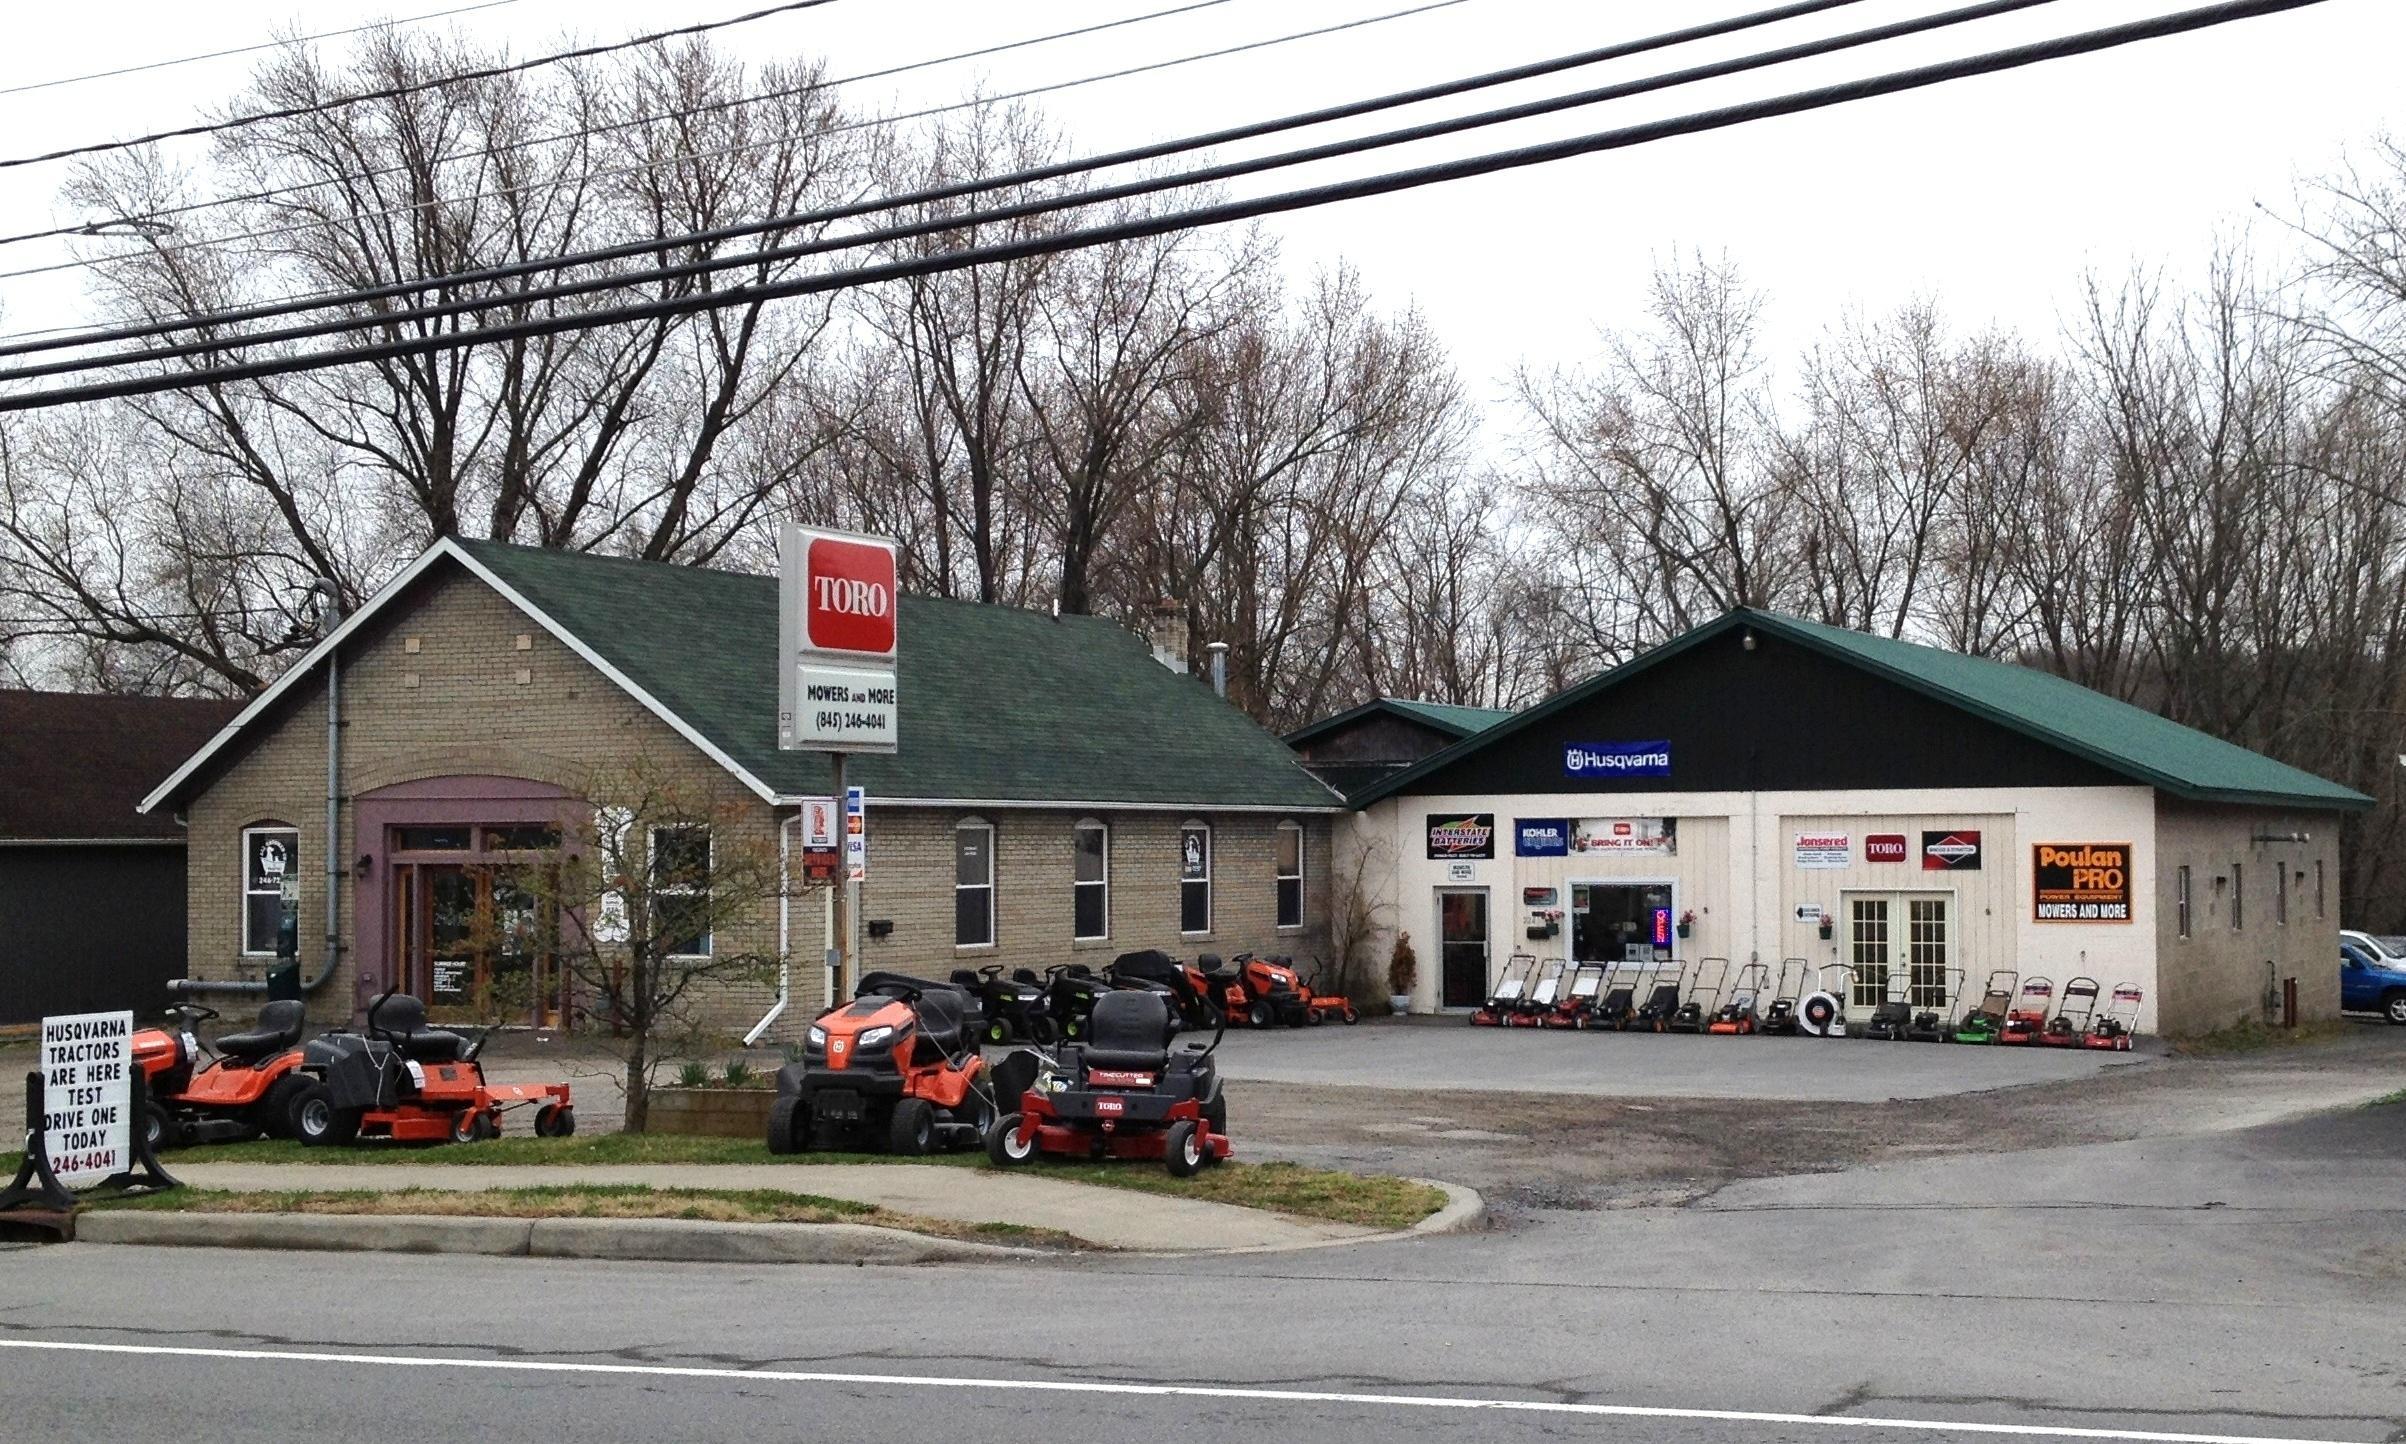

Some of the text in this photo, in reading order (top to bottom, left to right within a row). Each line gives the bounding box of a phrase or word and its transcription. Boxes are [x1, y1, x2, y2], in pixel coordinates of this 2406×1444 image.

[814, 575, 888, 617] TORO
[807, 684, 895, 705] MOWERS AND MORE
[816, 711, 886, 732] (845) 246-4041
[1584, 751, 1669, 770] Husqvarna
[1430, 826, 1491, 838] INTERSTATE
[1432, 837, 1487, 846] BATTERIES
[1522, 828, 1558, 838] KOHLER
[1591, 838, 1621, 847] BRING
[1623, 838, 1634, 847] IT
[1797, 836, 1848, 846] Jonsered
[1867, 842, 1904, 854] TORO
[2040, 845, 2122, 868] Poulan
[2073, 868, 2124, 889] PRO
[2038, 903, 2127, 918] MOWERS AND MORE
[46, 1019, 126, 1043] HUSQVARNA
[49, 1041, 120, 1065] TRACTORS
[50, 1062, 121, 1087] ARE HERE
[68, 1086, 103, 1106] TEST
[1098, 1101, 1123, 1111] TORO
[44, 1106, 117, 1132] DRIVE ONE
[63, 1129, 107, 1151] TODAY
[52, 1149, 117, 1175] 246-4041
